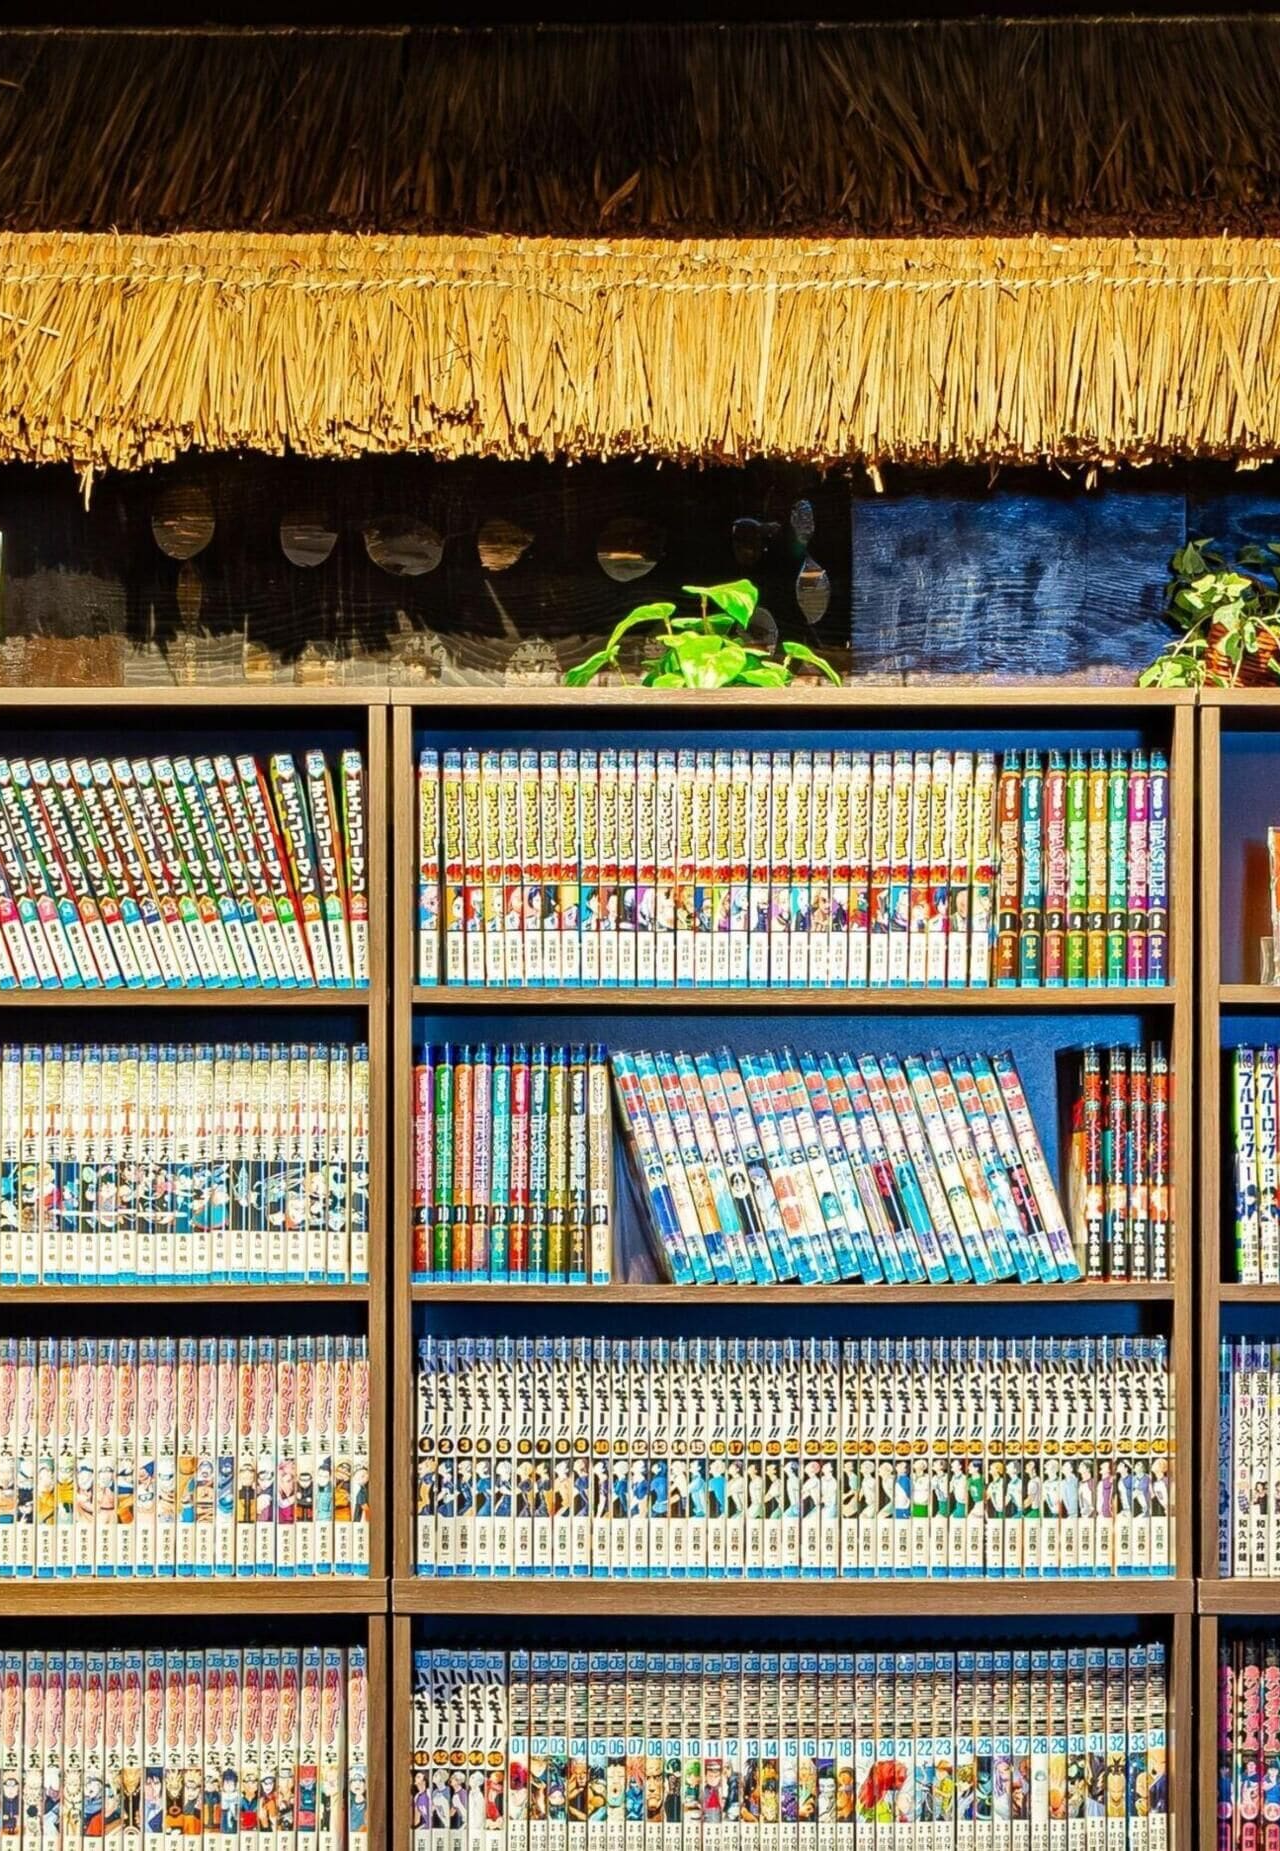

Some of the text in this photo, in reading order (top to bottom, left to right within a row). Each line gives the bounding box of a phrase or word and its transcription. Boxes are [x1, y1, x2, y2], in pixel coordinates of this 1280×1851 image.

[1239, 1072, 1255, 1158] ブルーロック
[511, 1739, 525, 1754] 01
[1033, 1738, 1048, 1754] 28
[1090, 1735, 1103, 1750] 31
[1109, 1736, 1124, 1751] 32
[1149, 1732, 1164, 1747] 34
[571, 1740, 586, 1755] 04
[590, 1740, 606, 1755] 05
[687, 1741, 700, 1756] 10
[725, 1740, 738, 1755] 12
